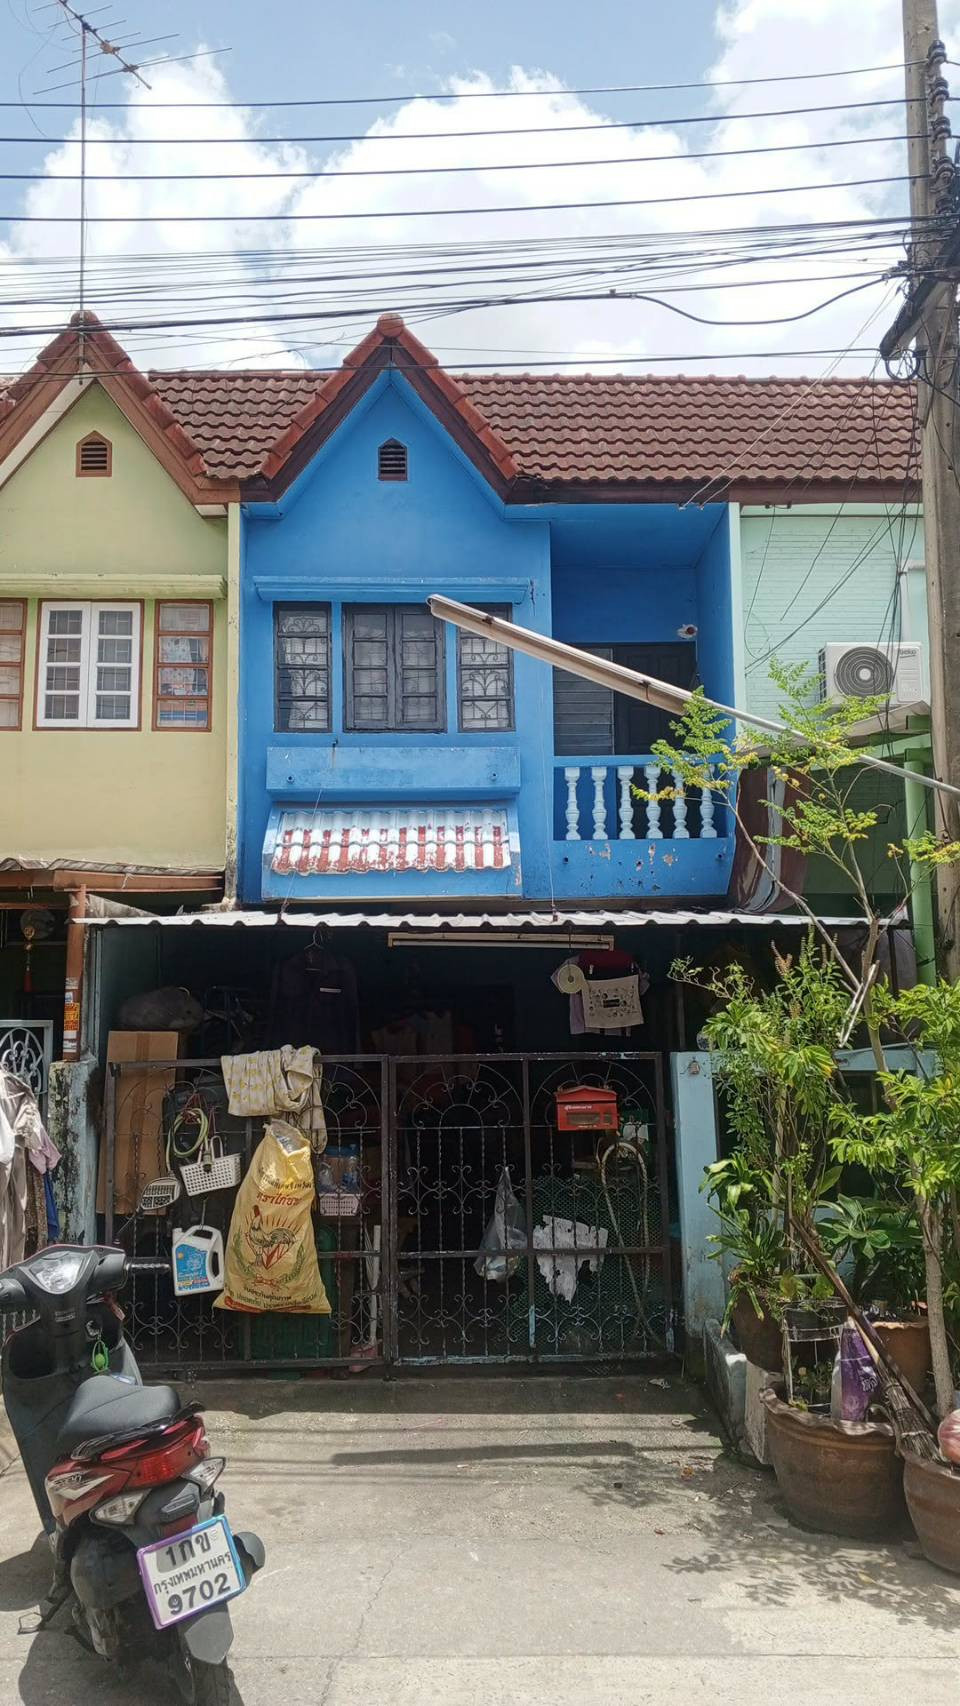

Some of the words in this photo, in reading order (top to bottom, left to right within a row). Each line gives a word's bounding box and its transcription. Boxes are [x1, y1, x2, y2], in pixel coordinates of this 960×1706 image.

[165, 1532, 211, 1567] 1กข
[153, 1552, 232, 1594] กรุงเทพมหานคร
[168, 1573, 231, 1615] 9702
